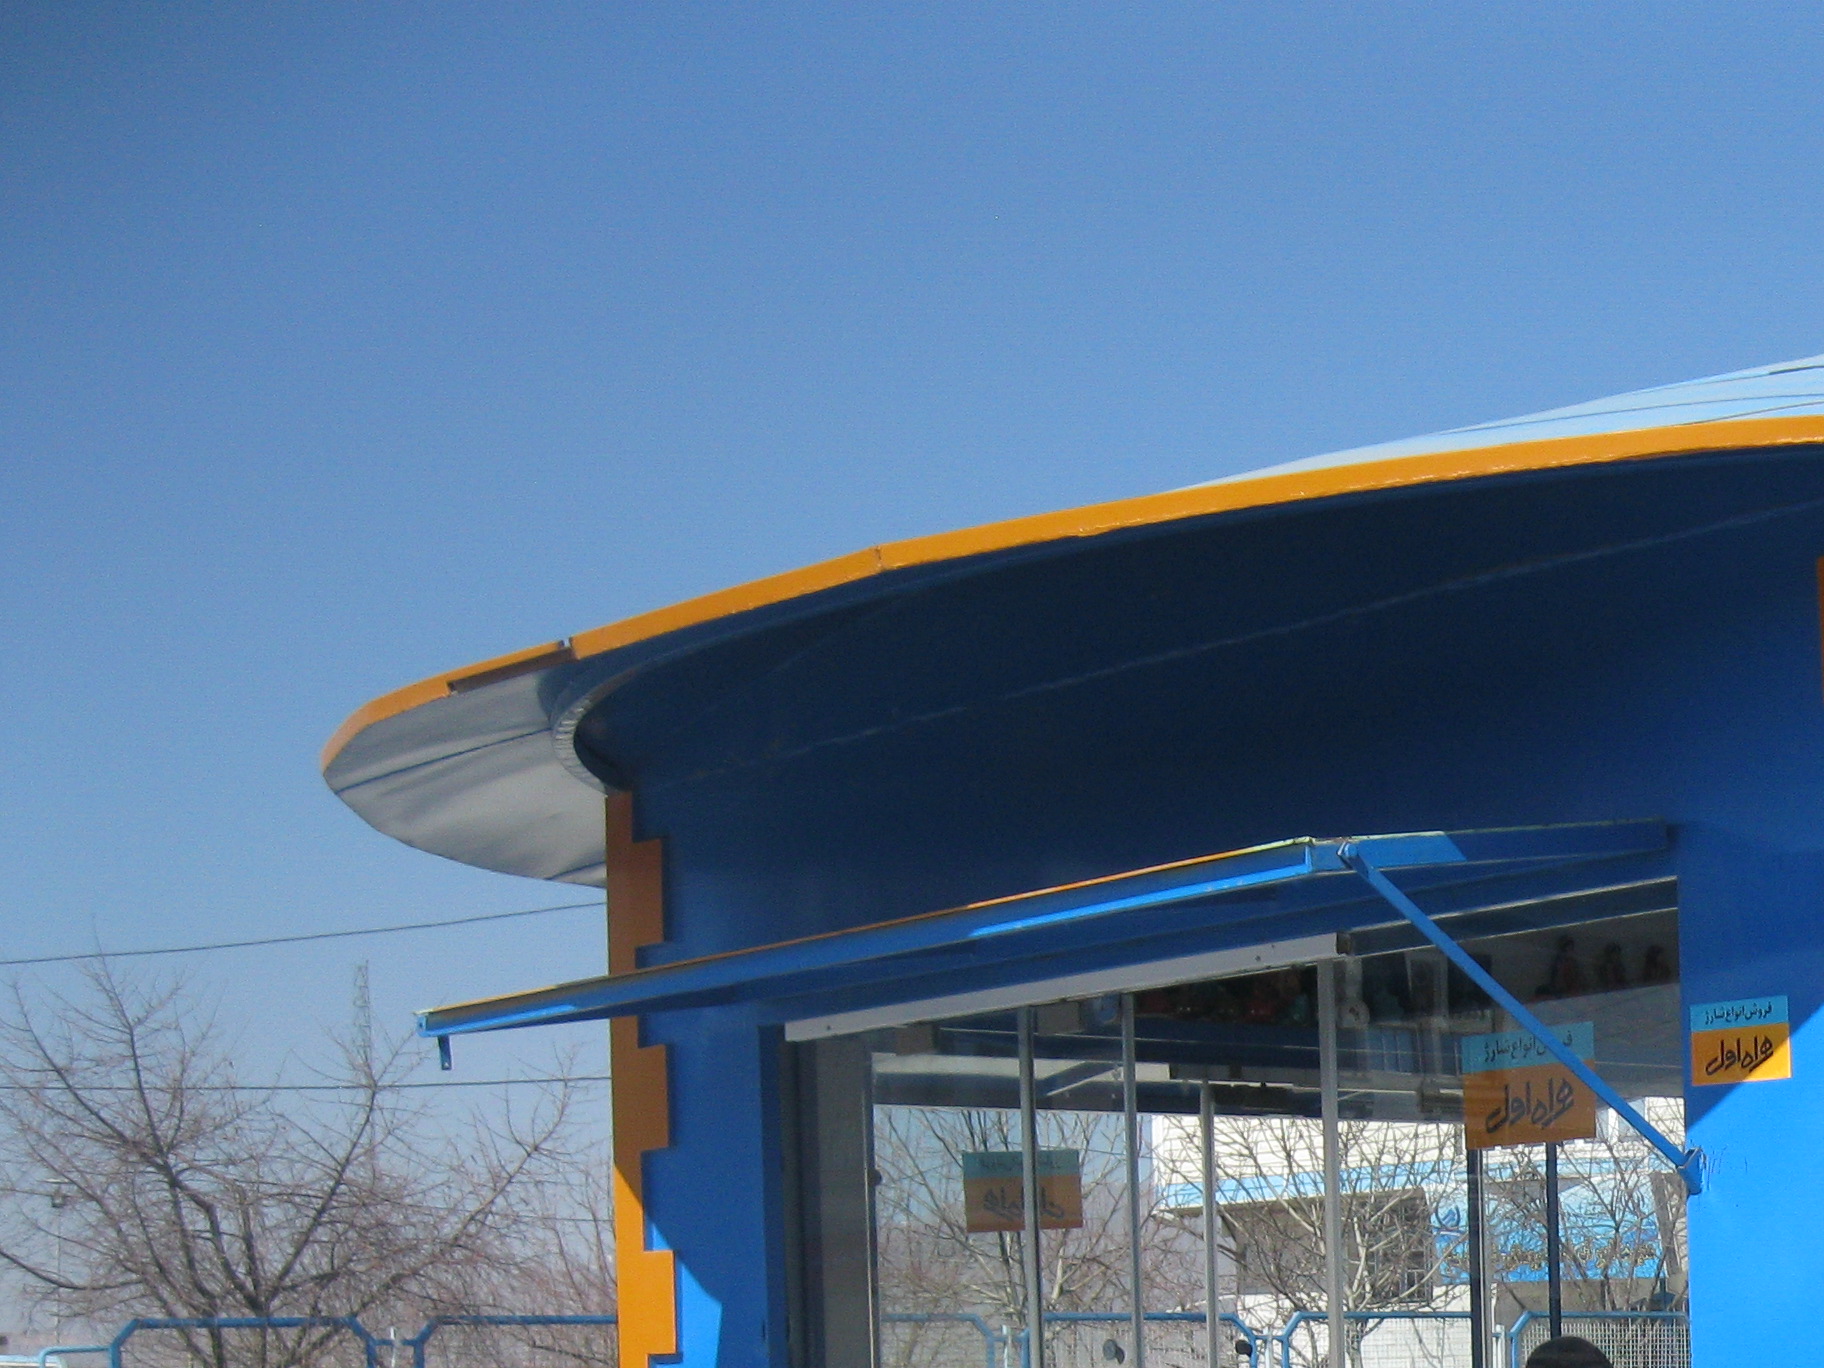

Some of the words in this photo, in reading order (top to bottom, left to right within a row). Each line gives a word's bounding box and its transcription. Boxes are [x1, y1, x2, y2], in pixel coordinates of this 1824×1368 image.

[1725, 1005, 1745, 1023] انواع
[1745, 1001, 1773, 1021] فروش
[1510, 1036, 1537, 1058] انواع
[1705, 1038, 1741, 1077] اول
[1740, 1034, 1775, 1074] همراه
[1485, 1081, 1532, 1134] اول
[1530, 1076, 1575, 1130] همراه
